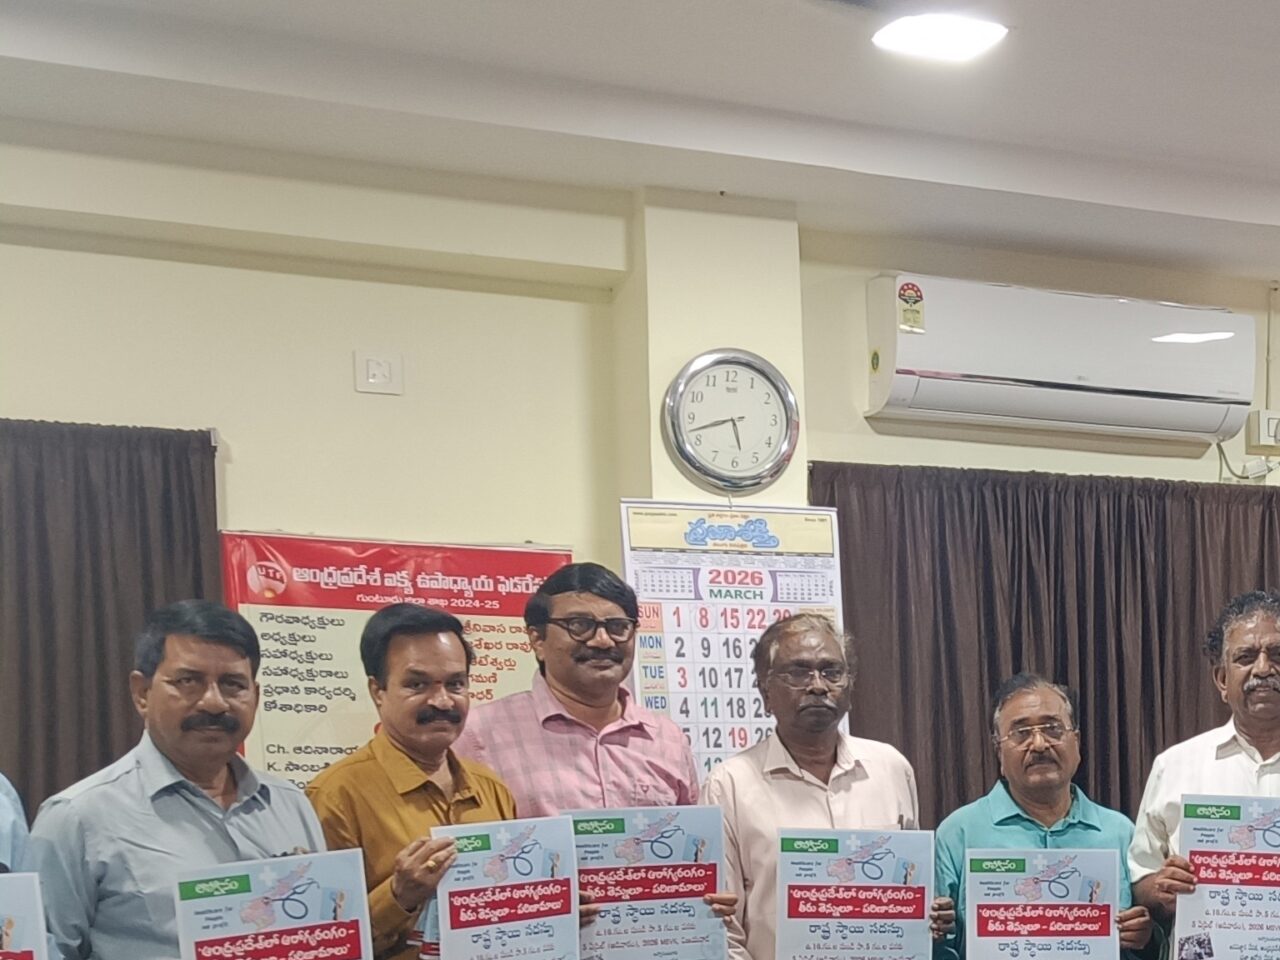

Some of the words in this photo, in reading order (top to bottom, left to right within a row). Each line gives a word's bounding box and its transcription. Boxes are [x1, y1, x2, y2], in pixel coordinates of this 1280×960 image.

[706, 375, 716, 387] 11
[726, 370, 738, 382] 12
[750, 377, 754, 389] 1
[691, 391, 704, 403] 10
[764, 392, 771, 405] 2
[688, 412, 695, 424] 9
[770, 414, 778, 427] 3
[694, 434, 702, 446] 8
[765, 436, 772, 448] 4
[712, 450, 719, 462] 7
[731, 456, 739, 468] 6
[752, 452, 759, 464] 5
[292, 565, 380, 590] ఆంధ్రప్రదేశ్
[416, 572, 494, 597] ఉపాధ్యాయ
[708, 569, 764, 586] 2026
[709, 589, 764, 600] MARCH
[450, 598, 500, 609] 2024-25
[260, 611, 346, 630] గౌరవాధ్యక్షులు
[638, 605, 659, 619] SUN
[673, 607, 681, 627] 1
[699, 607, 709, 628] 8
[720, 608, 740, 629] 15
[746, 608, 767, 629] 22
[261, 632, 317, 646] అధ్యక్షులు
[639, 636, 662, 649] MON
[675, 637, 686, 658] 2
[701, 638, 711, 659] 9
[722, 638, 742, 659] 16
[260, 648, 333, 664] సహాధ్యక్షులు
[262, 666, 349, 682] సహాధ్యక్షురాలు
[642, 666, 665, 679] TUE
[677, 667, 687, 688] 3
[699, 667, 718, 688] 10
[725, 668, 744, 689] 17
[263, 684, 301, 697] ప్రధాన
[263, 700, 328, 714] కోశాధికారి
[644, 696, 667, 710] WED
[680, 697, 690, 718] 4
[701, 697, 719, 718] 11
[727, 697, 746, 719] 18
[702, 727, 722, 748] 12
[729, 727, 747, 748] 19
[266, 744, 289, 755] Ch.
[267, 762, 281, 772] K.
